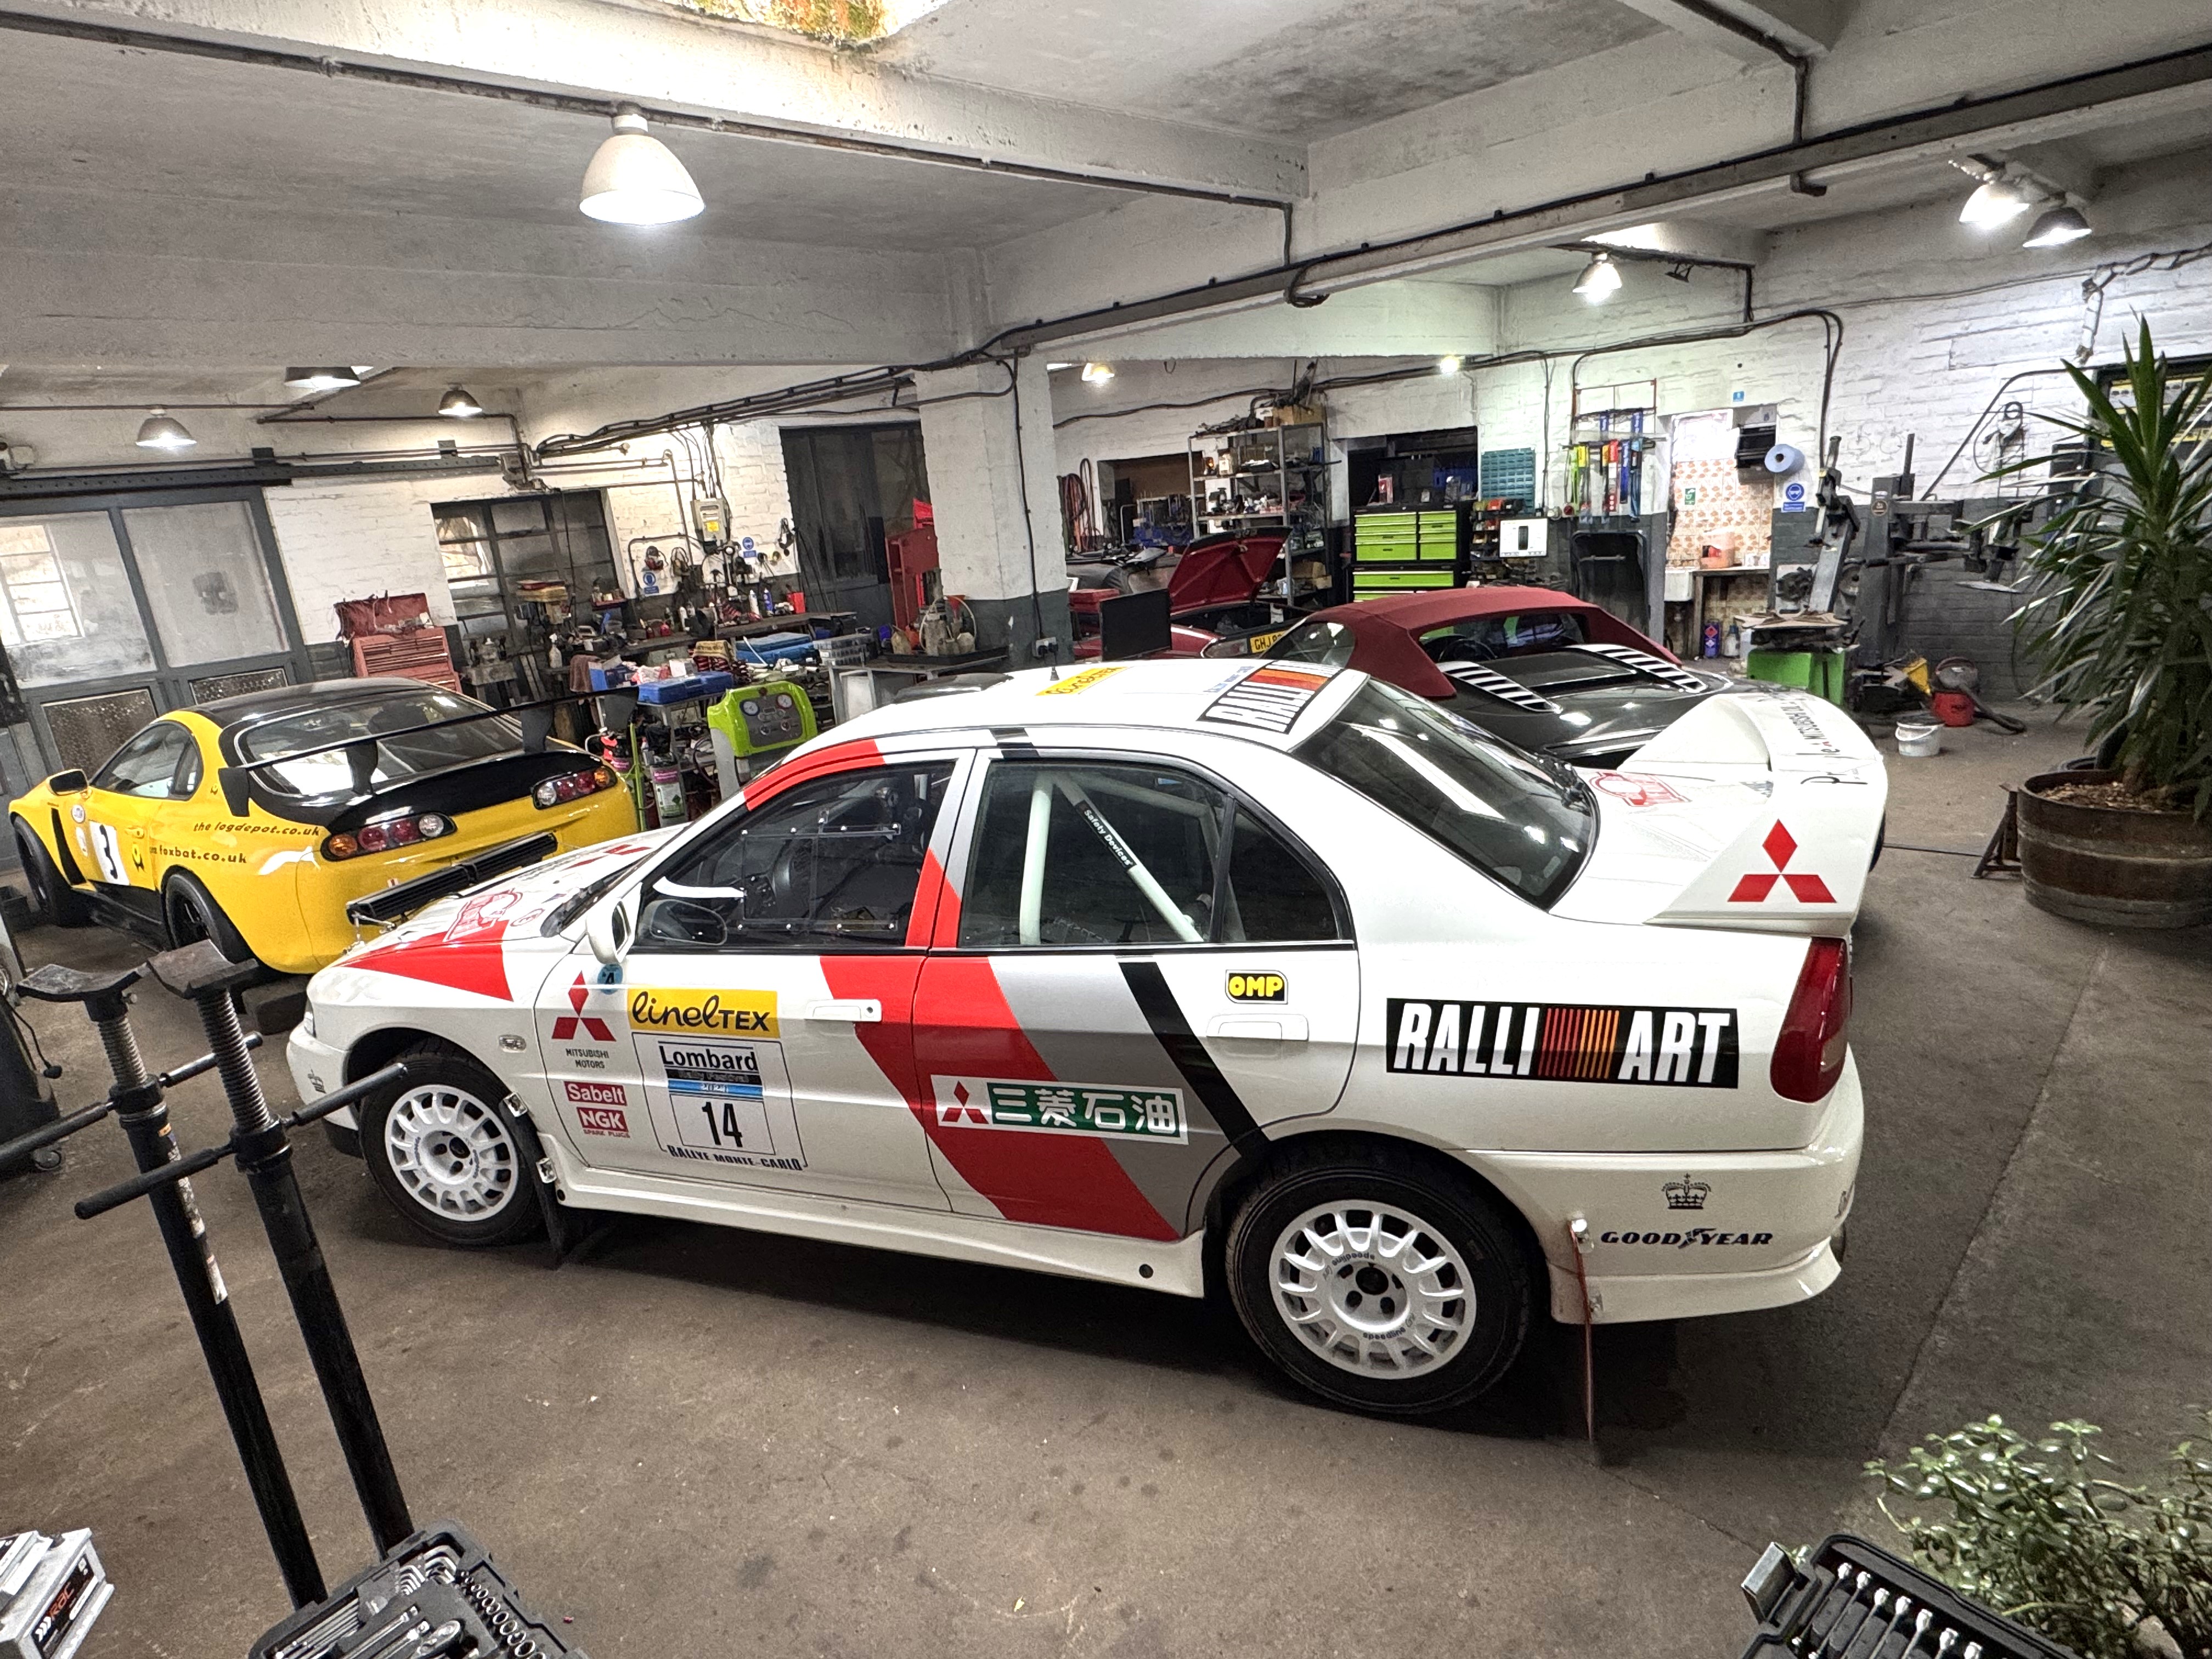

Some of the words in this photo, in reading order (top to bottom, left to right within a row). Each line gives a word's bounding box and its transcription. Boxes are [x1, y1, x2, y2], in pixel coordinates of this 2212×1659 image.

[194, 822, 211, 832] the
[1084, 809, 1106, 834] Safety
[1104, 834, 1130, 866] Devices
[99, 824, 119, 879] 3
[1228, 975, 1283, 997] OMP
[565, 1048, 610, 1059] MITSUBISHI
[1393, 1002, 1541, 1076] RALLI
[1617, 1010, 1730, 1084] ART
[575, 1059, 605, 1069] MOTORS
[659, 1045, 759, 1070] Lombard
[567, 1083, 625, 1104] Sabelt
[579, 1109, 625, 1130] NGK
[992, 1086, 1177, 1135] 三菱石油
[702, 1101, 743, 1148] 14
[667, 1144, 710, 1161] RALLYE
[1601, 1228, 1773, 1249] GOODYEAR
